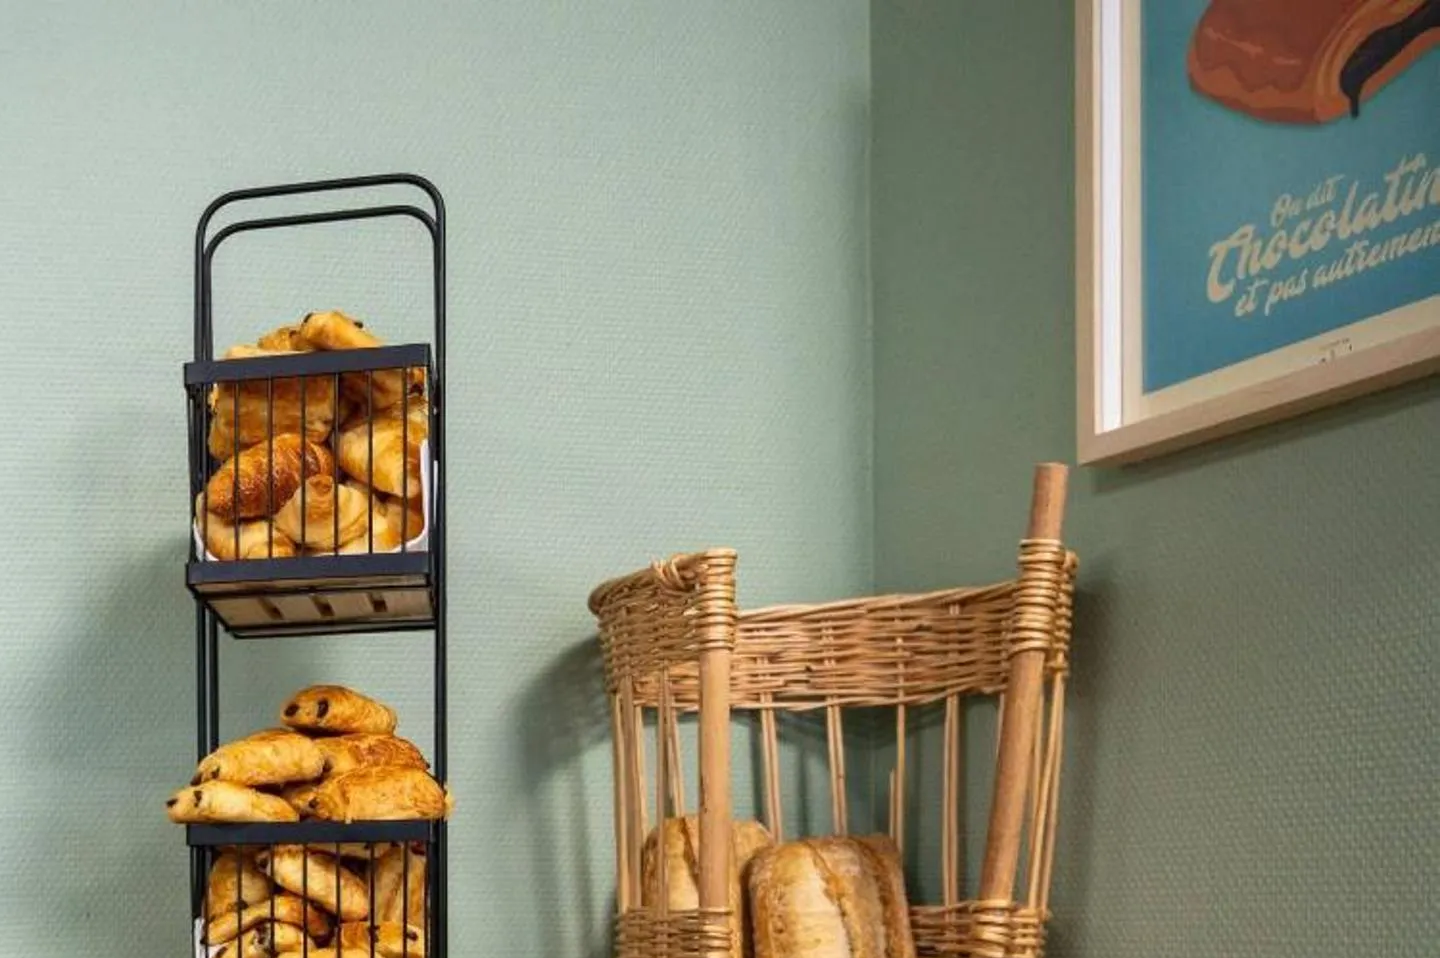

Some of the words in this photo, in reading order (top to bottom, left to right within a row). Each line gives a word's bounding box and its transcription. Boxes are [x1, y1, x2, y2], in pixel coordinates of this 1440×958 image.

[1306, 174, 1345, 209] dit
[1235, 279, 1268, 317] et
[1264, 268, 1308, 316] pas
